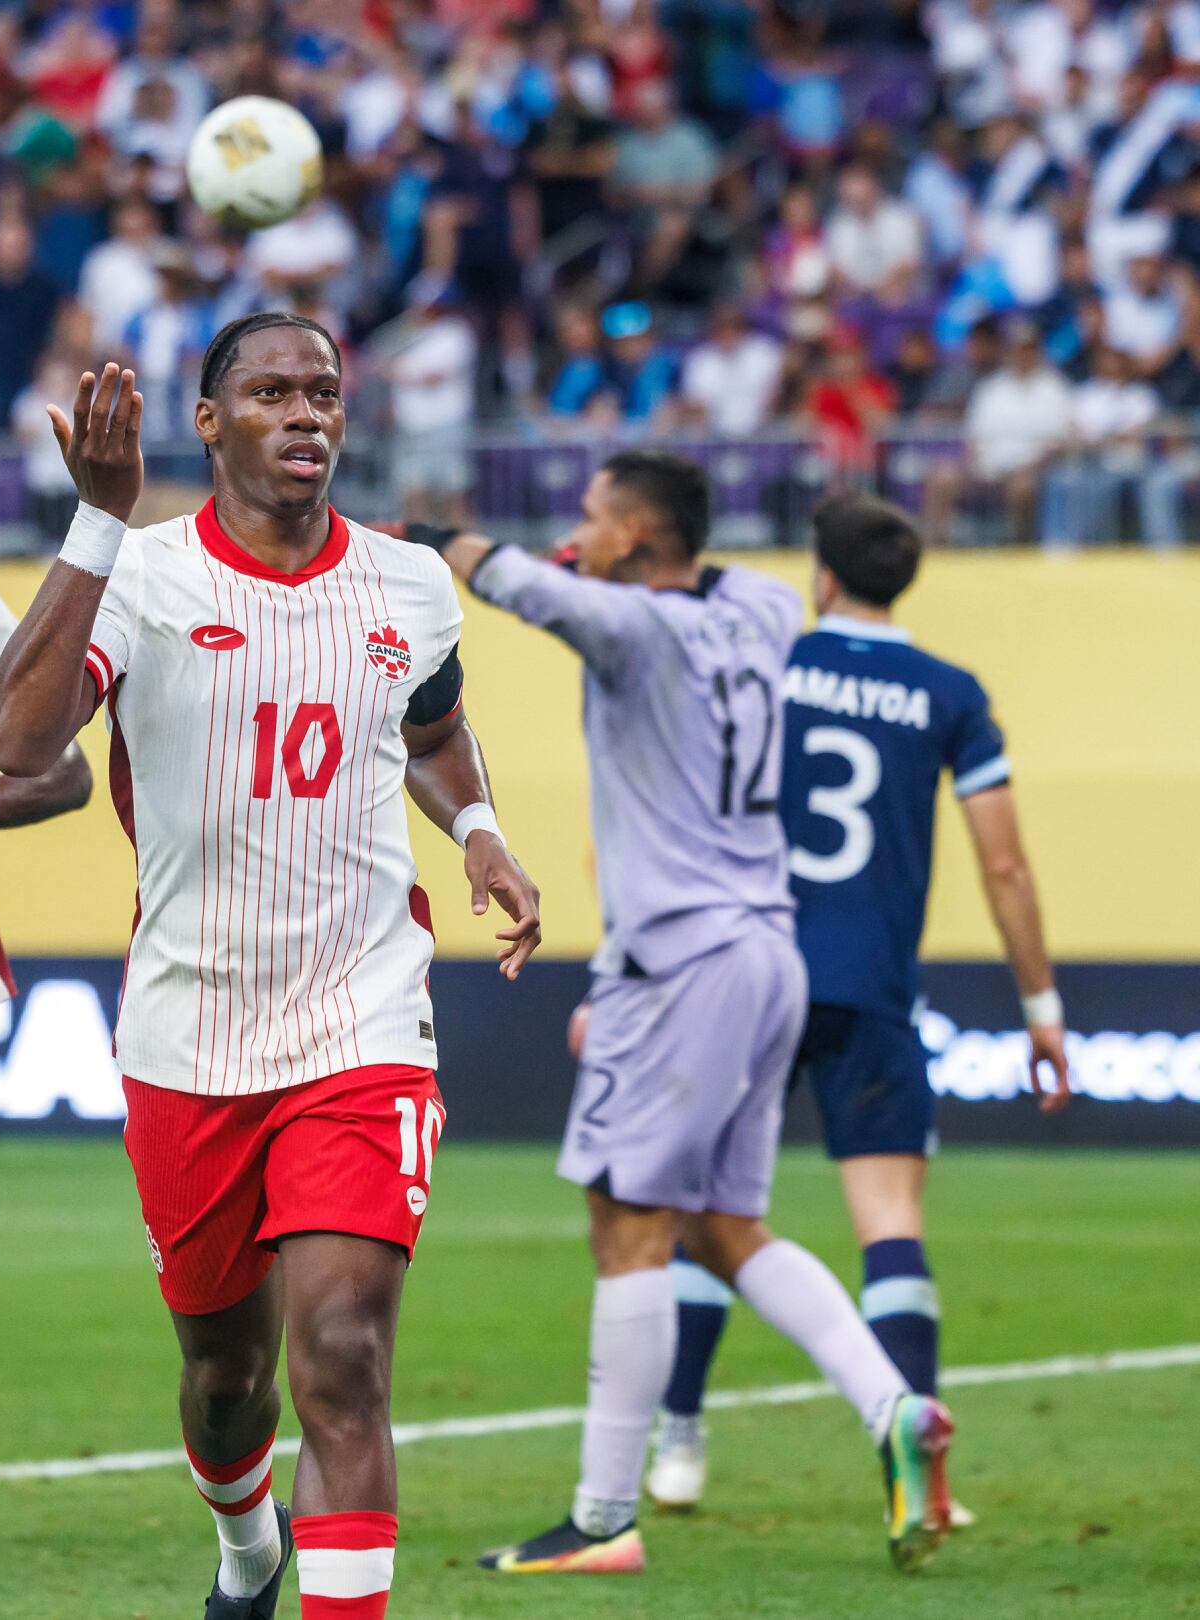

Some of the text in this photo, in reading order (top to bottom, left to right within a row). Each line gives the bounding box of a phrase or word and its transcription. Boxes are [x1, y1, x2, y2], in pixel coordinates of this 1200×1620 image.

[365, 643, 412, 664] CANADA
[782, 665, 930, 730] AMAYOA
[252, 702, 343, 800] 10
[713, 668, 779, 817] 12
[789, 725, 882, 884] 3
[395, 1097, 442, 1185] 10
